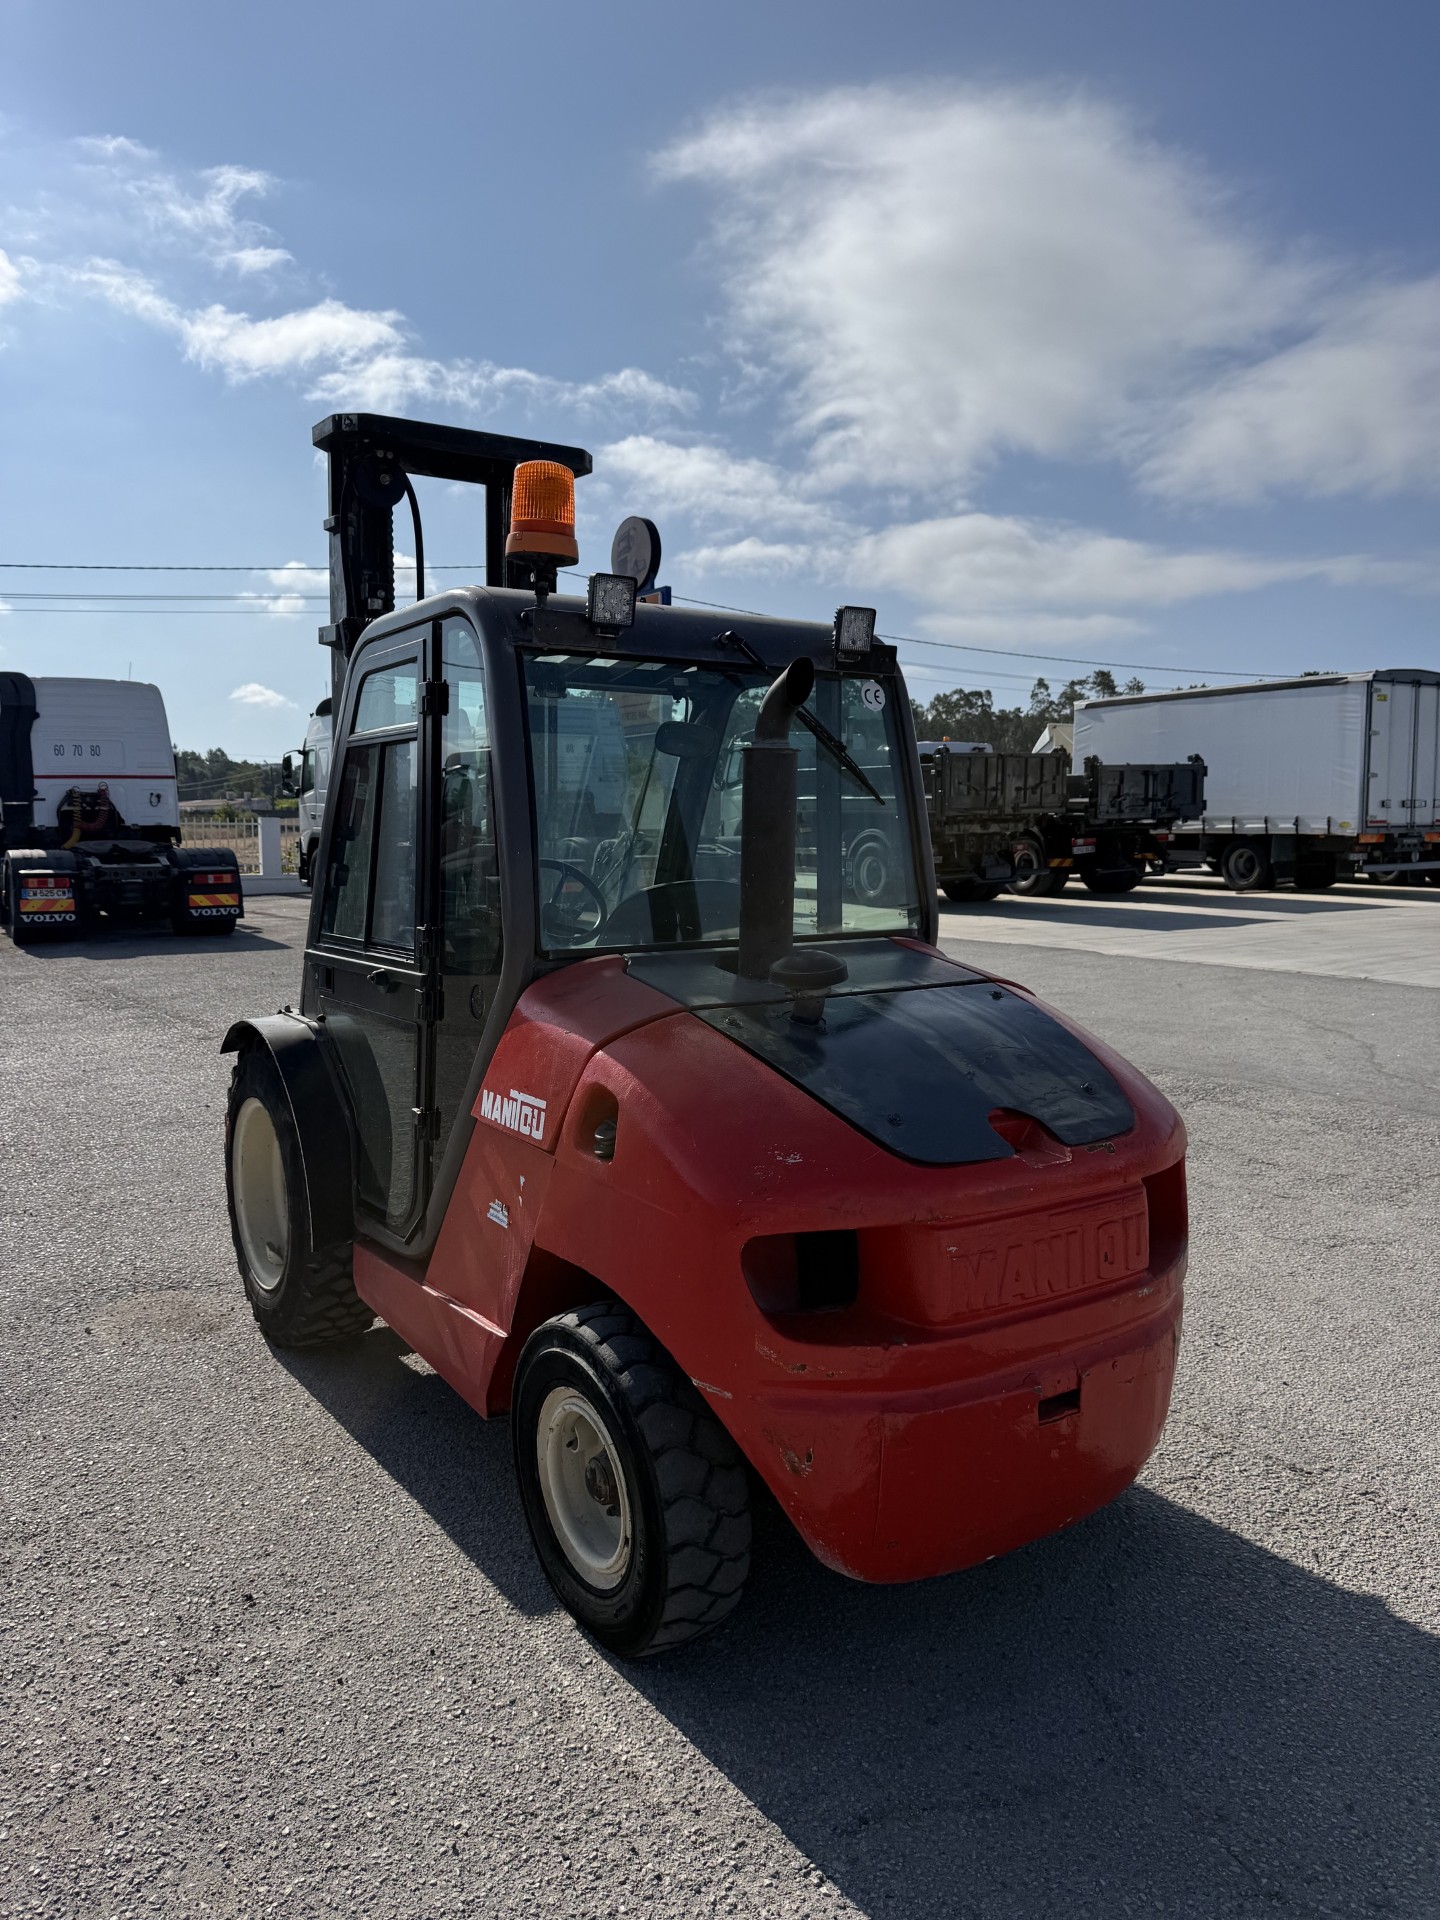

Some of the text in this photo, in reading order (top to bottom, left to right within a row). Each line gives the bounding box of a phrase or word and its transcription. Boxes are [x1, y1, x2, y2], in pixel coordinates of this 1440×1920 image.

[864, 688, 882, 704] CE
[53, 744, 101, 757] 60 70 80
[20, 913, 76, 923] VOLVO
[190, 907, 240, 917] VOLVO
[480, 1089, 547, 1141] MANITOU
